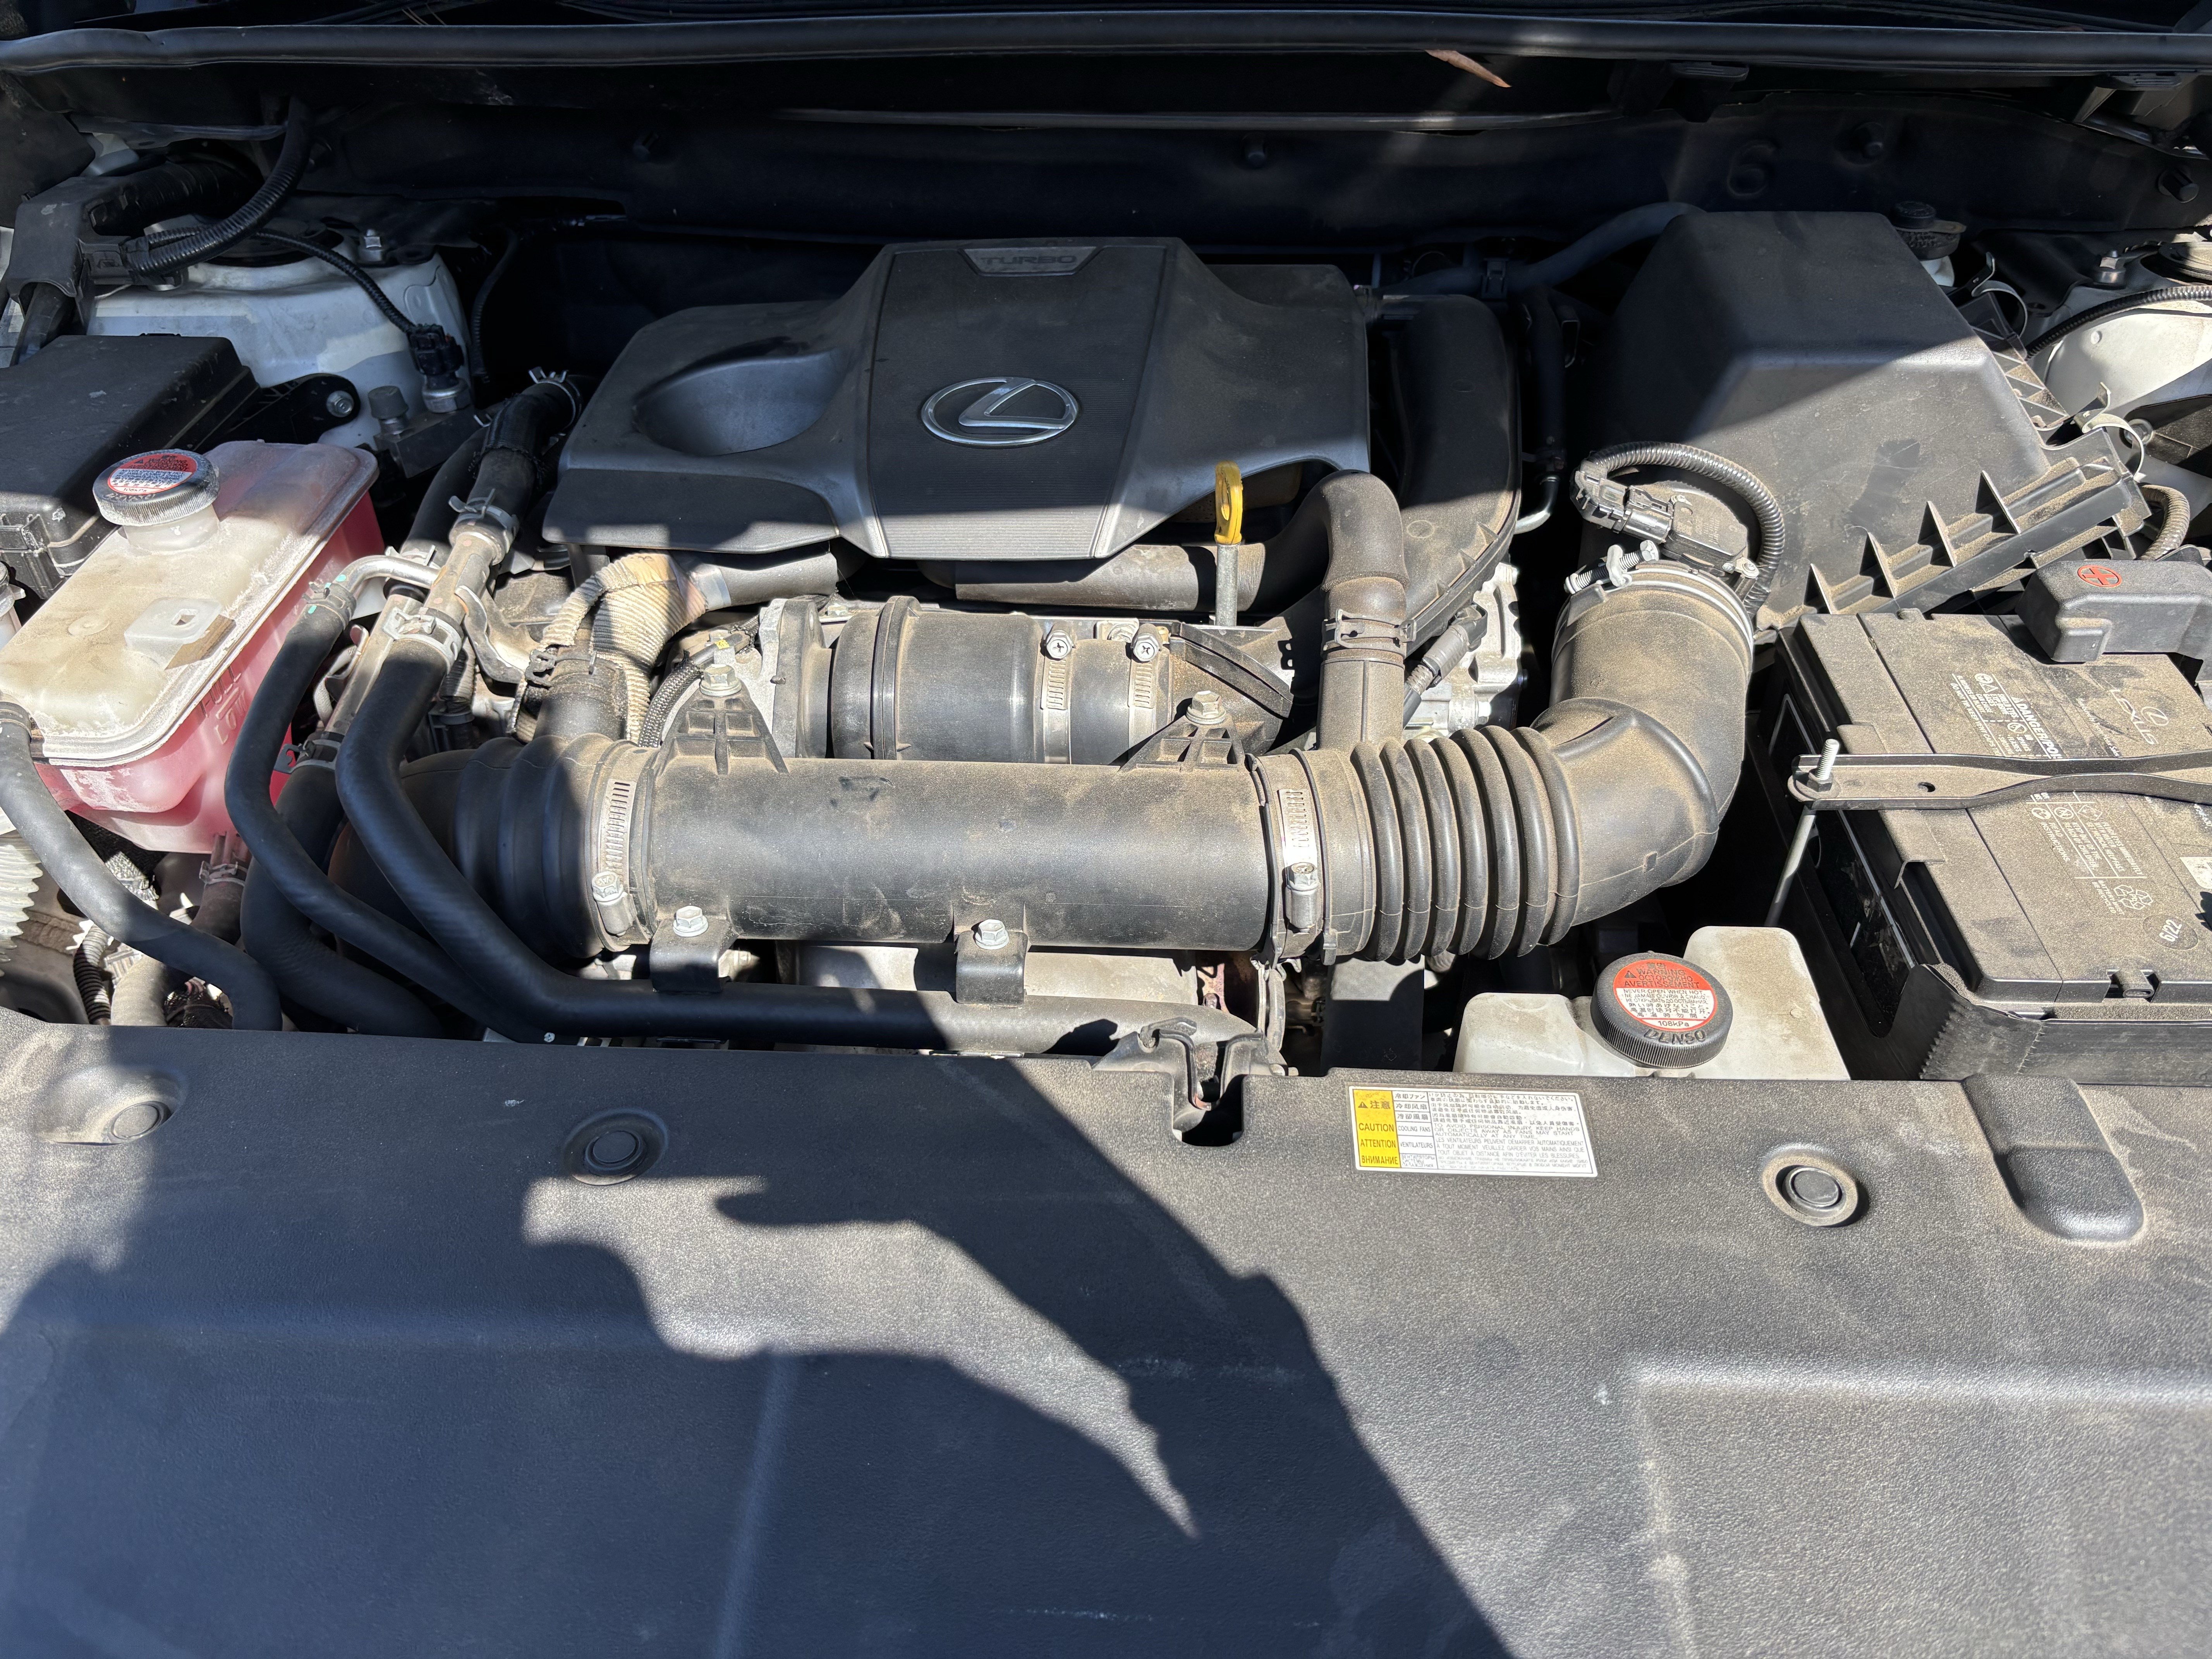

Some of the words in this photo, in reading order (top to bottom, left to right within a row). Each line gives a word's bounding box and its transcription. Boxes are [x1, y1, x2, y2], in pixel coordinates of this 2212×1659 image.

[981, 256, 1077, 264] TURBO
[1955, 690, 1966, 702] NOT
[1966, 708, 1979, 721] KEEP
[1983, 734, 1996, 747] CAPS
[2049, 822, 2063, 837] READ
[2071, 822, 2084, 833] KEEP
[2079, 834, 2092, 844] OUT
[2090, 852, 2102, 860] THE
[2097, 889, 2116, 914] RECYCLED
[2098, 880, 2116, 902] BATTERY
[2112, 901, 2125, 915] MUST
[2159, 919, 2182, 942] 6/22
[1624, 980, 1700, 988] AVERTISSEMENT
[1644, 1029, 1706, 1045] DENSO
[1370, 1101, 1391, 1109] 注意
[1359, 1123, 1394, 1132] CAUTION
[1360, 1139, 1396, 1148] ATTENTION
[1362, 1155, 1398, 1165] ВНИМАНИЕ
